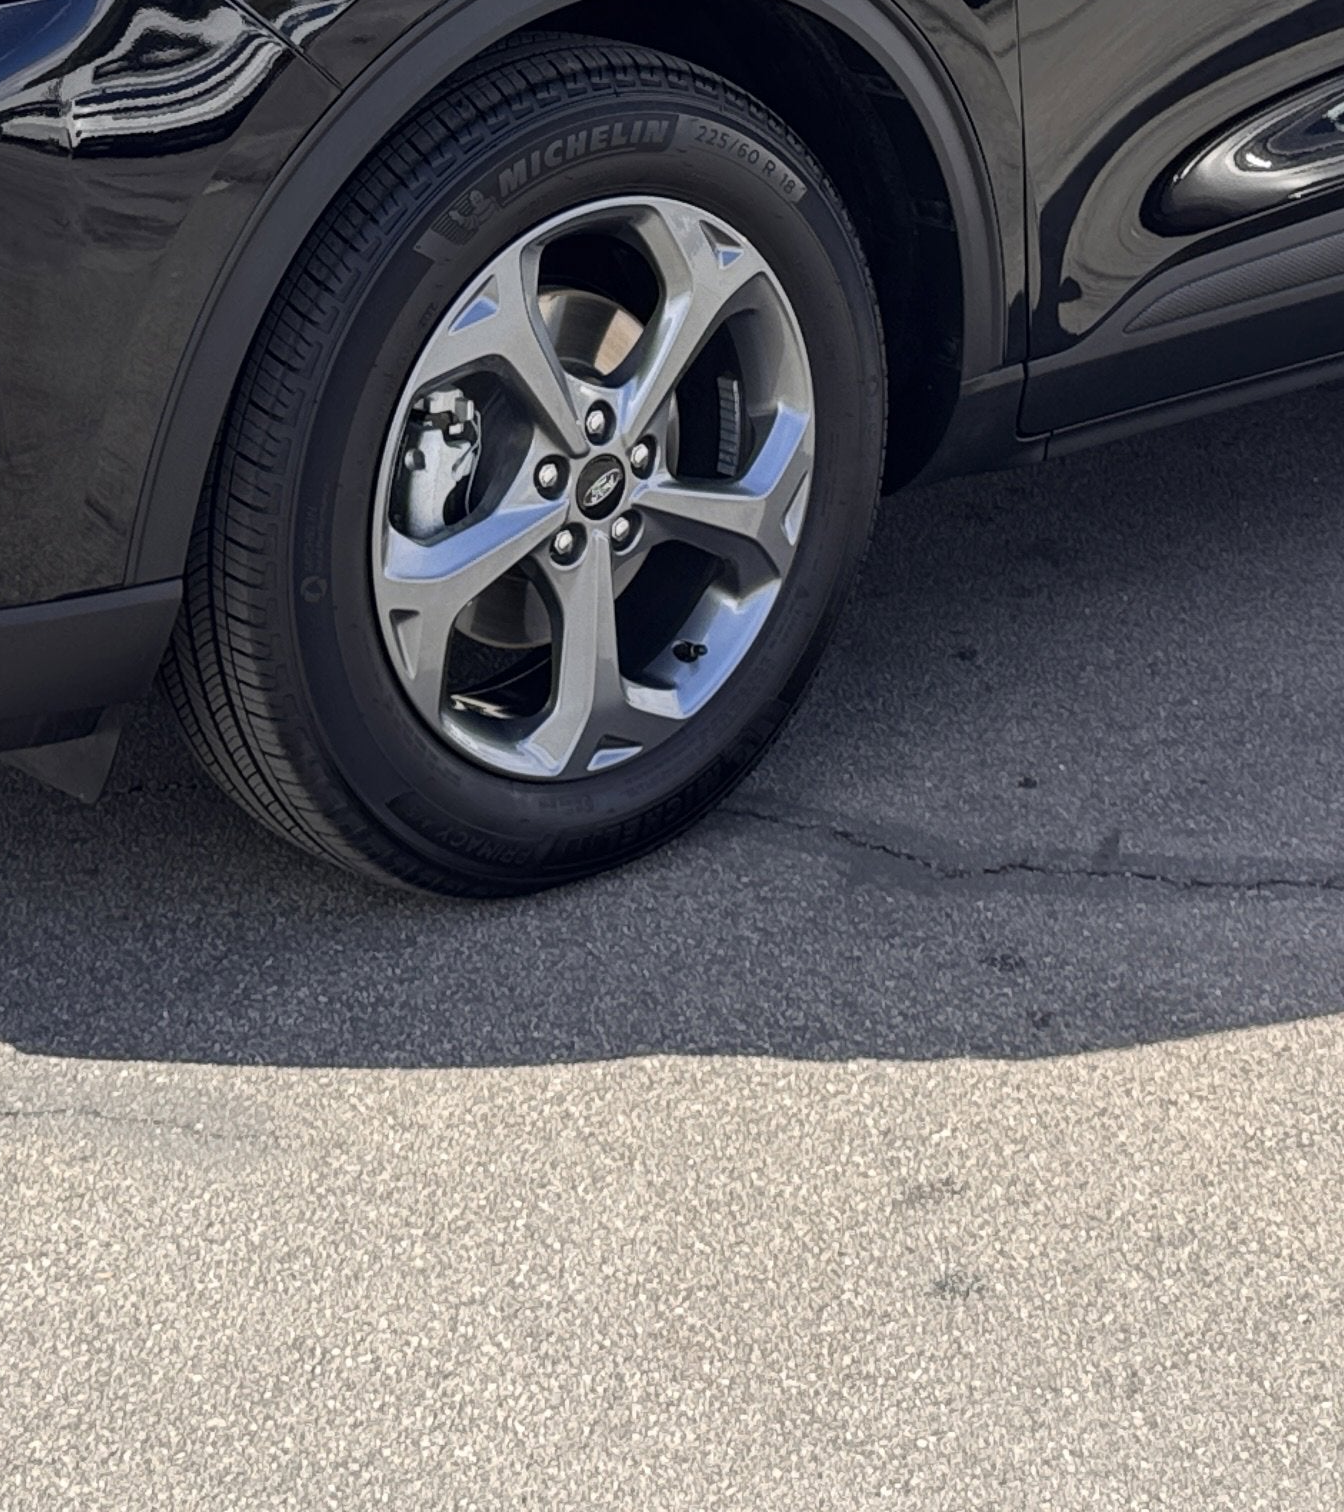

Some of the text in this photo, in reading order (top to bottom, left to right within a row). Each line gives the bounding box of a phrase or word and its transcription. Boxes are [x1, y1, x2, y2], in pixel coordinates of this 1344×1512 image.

[497, 119, 670, 198] MICHELIN
[694, 125, 797, 196] 225/60 R 18
[434, 825, 532, 866] PRIMACY
